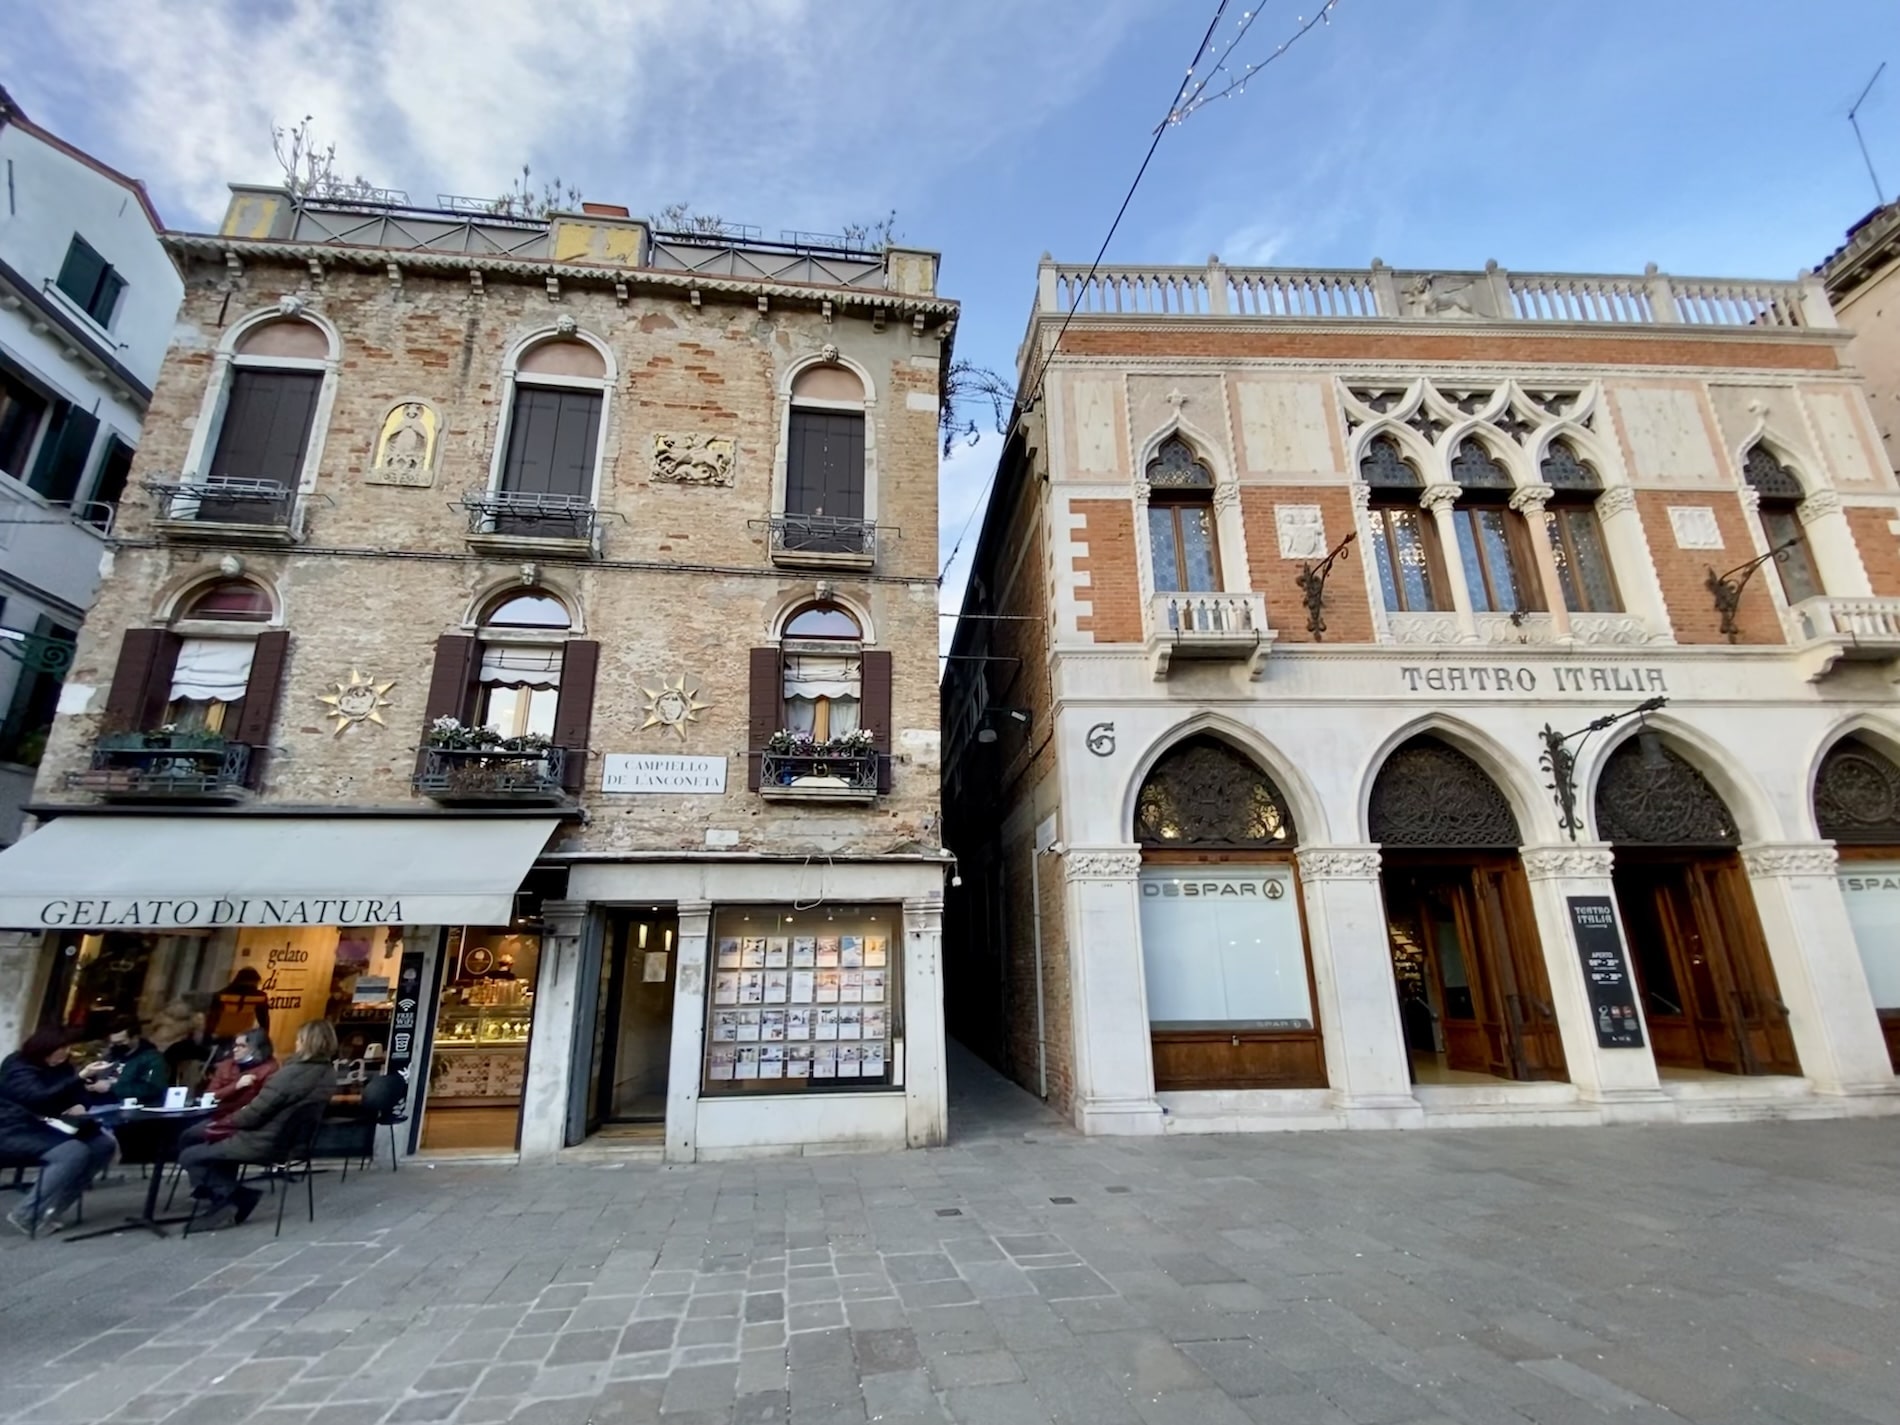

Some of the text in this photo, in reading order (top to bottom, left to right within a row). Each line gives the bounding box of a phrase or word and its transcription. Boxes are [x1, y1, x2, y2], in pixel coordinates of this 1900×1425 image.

[1400, 666, 1669, 692] TEATRO ITALIA
[624, 760, 708, 772] CAMPIELLO
[607, 775, 627, 785] DE
[1143, 883, 1257, 897] DESPAR
[40, 900, 404, 925] GELATO DI NATURA
[1574, 906, 1611, 915] TEATRO
[1577, 914, 1613, 924] ITALIA
[266, 941, 309, 970] gelato
[261, 969, 279, 991] di
[268, 996, 302, 1010] atura
